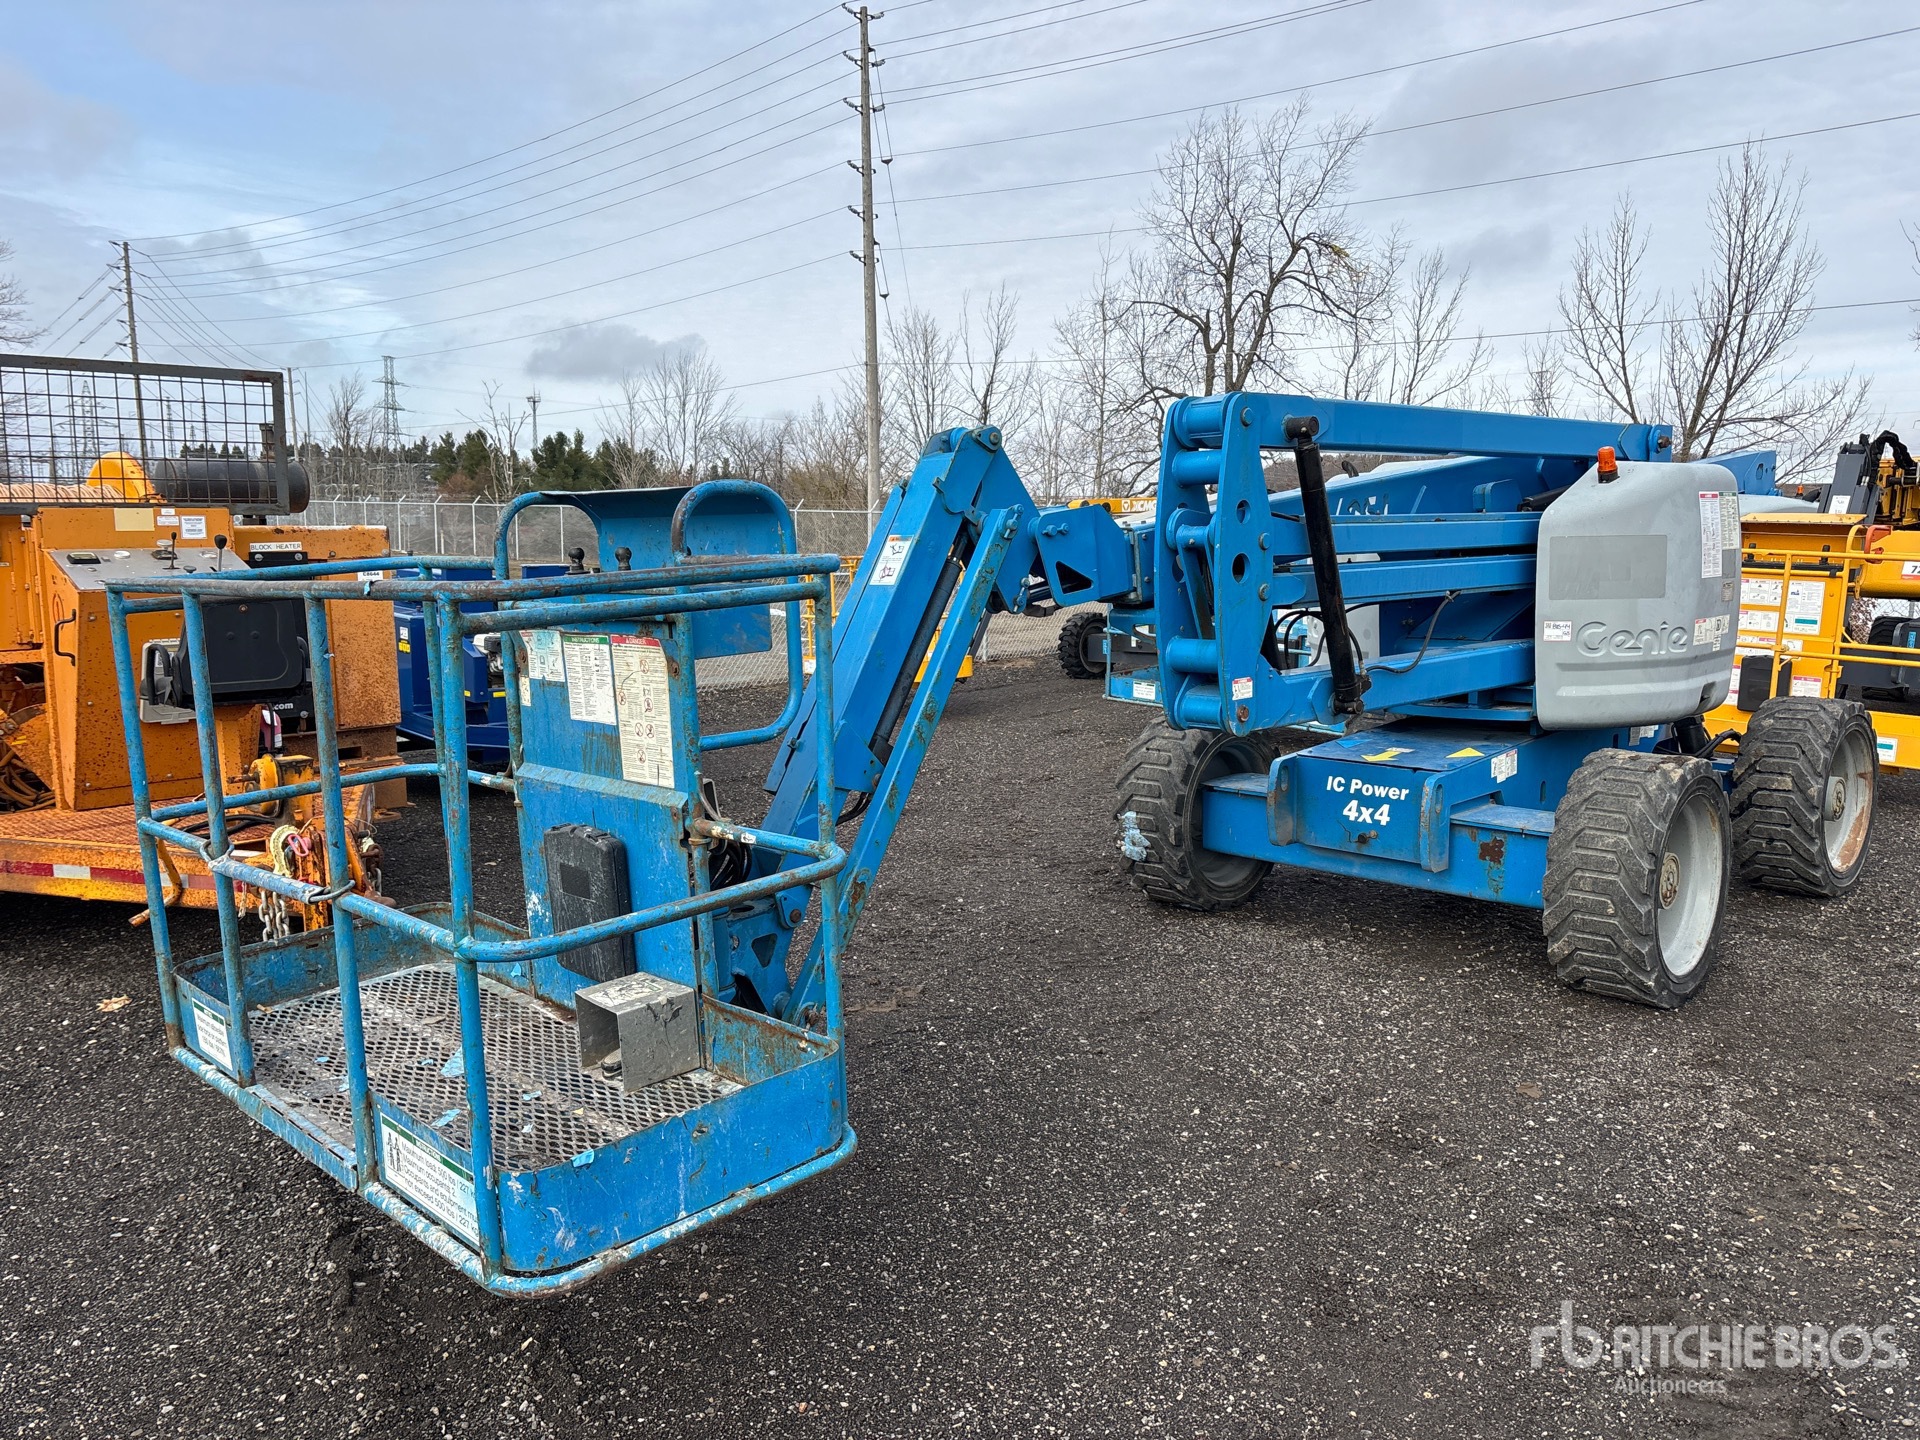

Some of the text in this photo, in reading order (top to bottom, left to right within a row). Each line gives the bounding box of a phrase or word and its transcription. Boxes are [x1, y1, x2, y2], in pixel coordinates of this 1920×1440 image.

[629, 637, 647, 645] DANGER
[1576, 620, 1688, 657] Genie
[1326, 775, 1410, 801] IC Power
[1342, 799, 1391, 826] 4x4
[401, 1141, 424, 1164] Maximum
[437, 1166, 447, 1181] 500
[447, 1173, 455, 1186] lbs
[458, 1180, 469, 1196] 227
[402, 1152, 425, 1176] Maximum
[403, 1163, 429, 1191] Occupants
[429, 1183, 439, 1196] and
[439, 1189, 467, 1218] equipment
[404, 1176, 413, 1189] not
[413, 1182, 433, 1204] exceed
[434, 1196, 445, 1212] 500
[445, 1204, 455, 1219] lbs
[458, 1213, 469, 1229] 227
